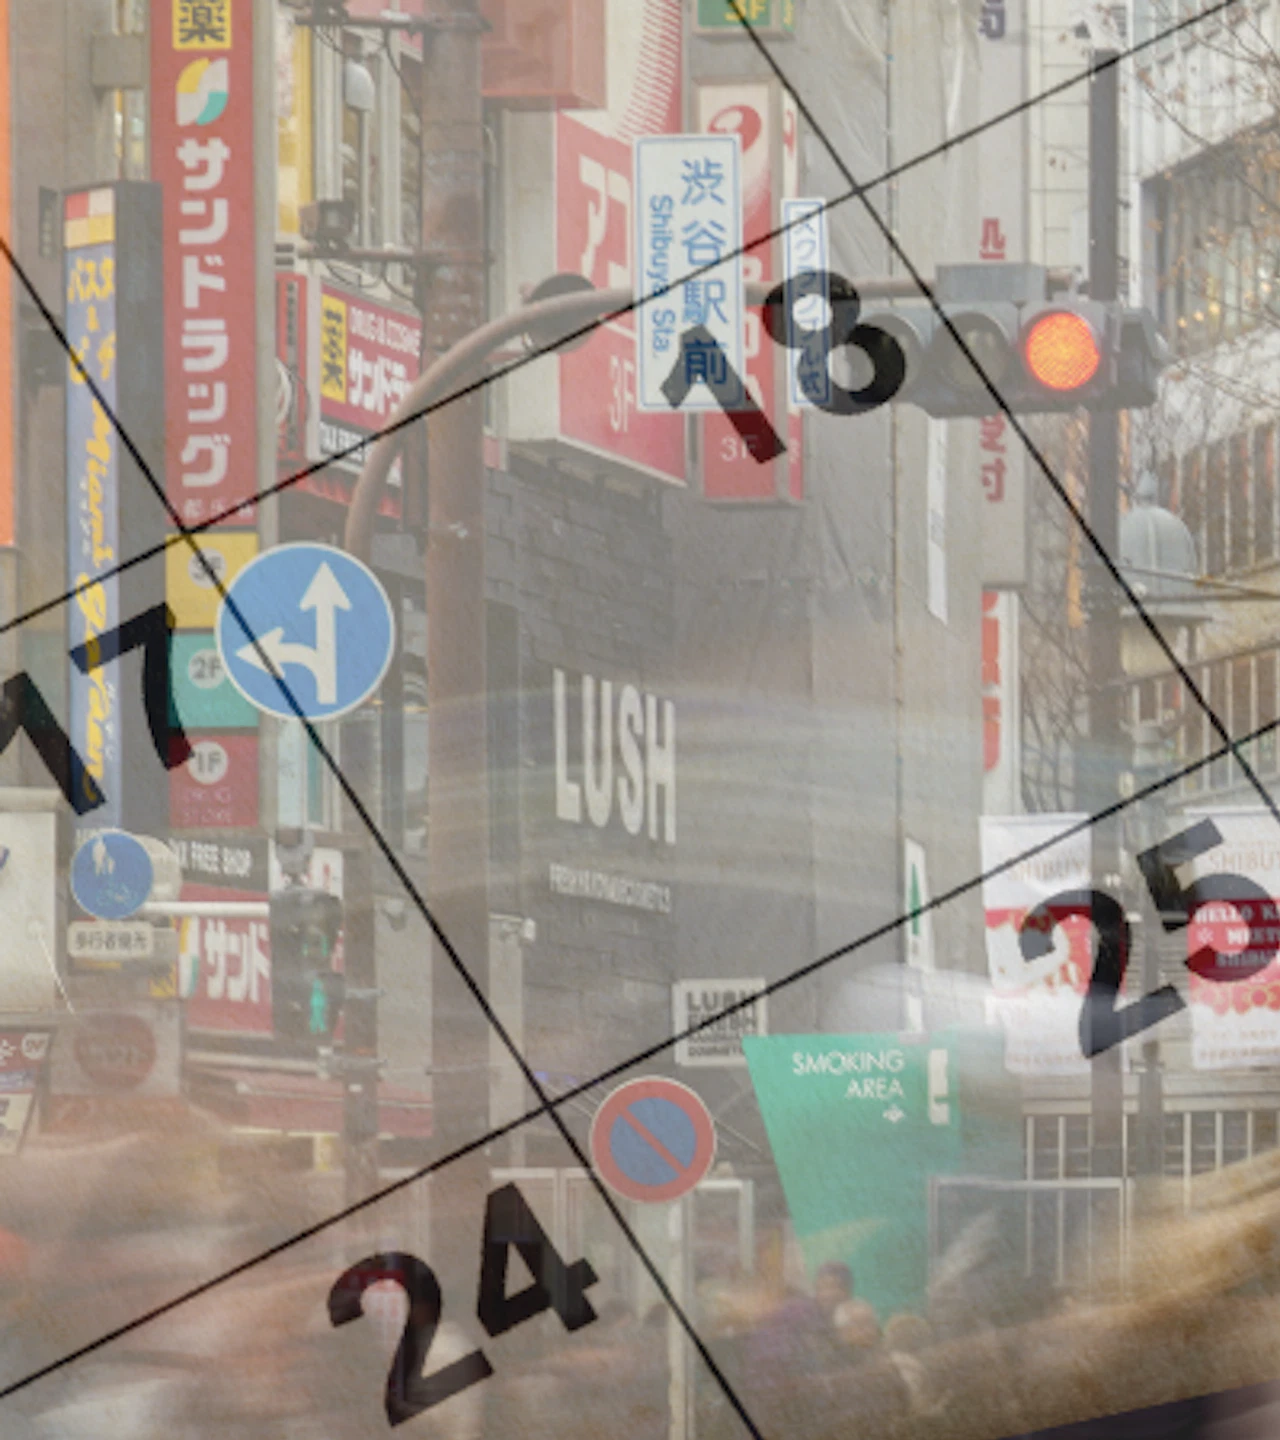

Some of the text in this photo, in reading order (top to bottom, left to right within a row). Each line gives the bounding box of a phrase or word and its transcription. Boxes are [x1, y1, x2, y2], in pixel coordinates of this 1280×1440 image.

[178, 137, 231, 488] サンドラッグ
[647, 194, 674, 299] Shibuya
[681, 156, 729, 385] 渋谷駅前
[660, 270, 906, 464] 18
[553, 667, 676, 845] LUSH
[1194, 904, 1253, 924] HELLO
[791, 1050, 906, 1076] SMOKING
[844, 1077, 906, 1101] AREA
[327, 1182, 599, 1427] 24
